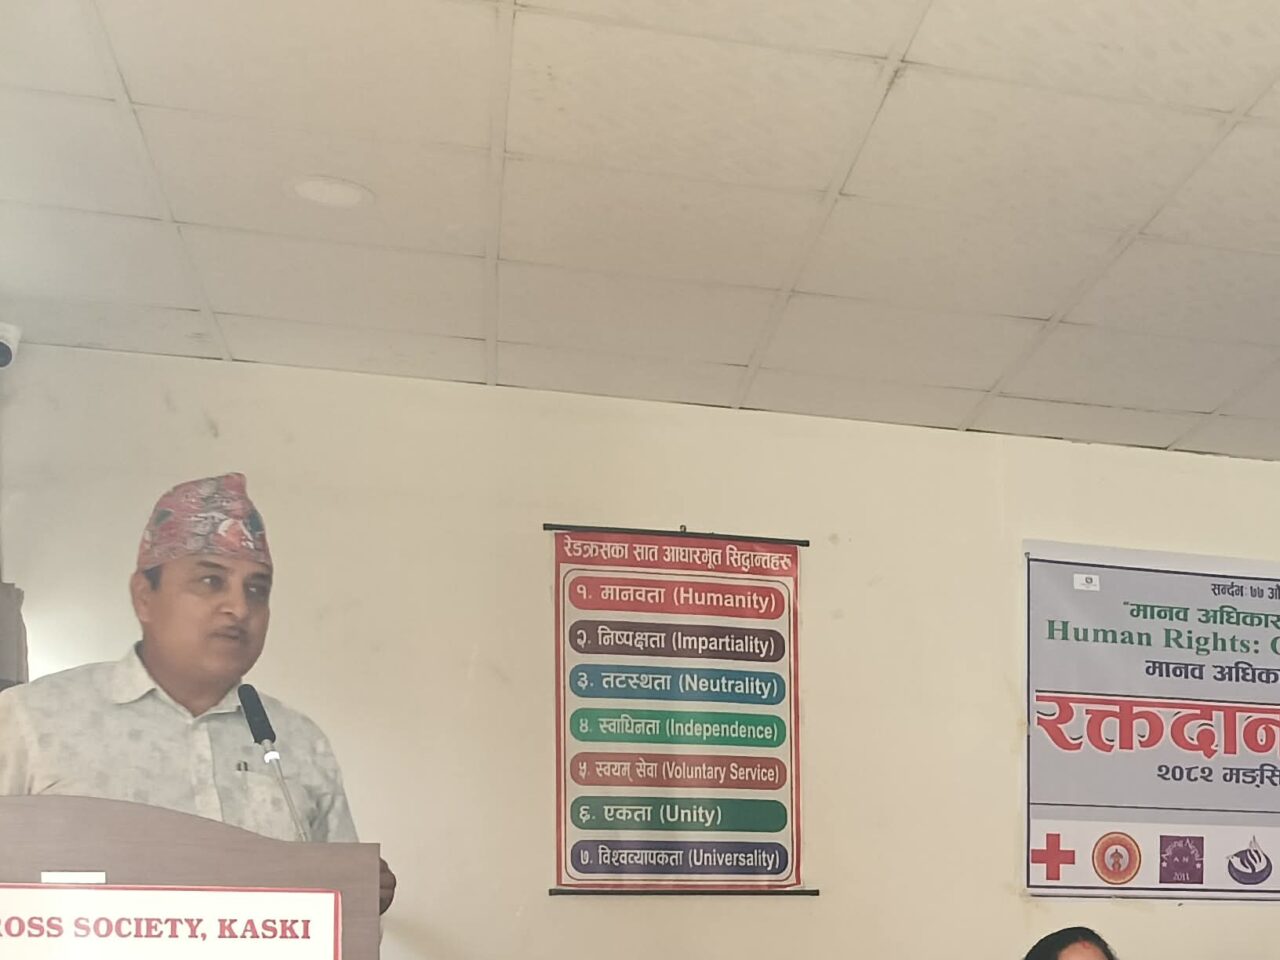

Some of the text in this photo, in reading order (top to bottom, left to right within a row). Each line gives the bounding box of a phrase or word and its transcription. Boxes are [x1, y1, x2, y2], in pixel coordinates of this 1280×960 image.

[632, 542, 658, 562] सात
[599, 585, 666, 606] मानवता
[672, 587, 777, 614] (Humanity)
[597, 625, 666, 650] निष्पक्षता
[671, 630, 775, 657] (Impartiality)
[1046, 619, 1153, 647] Human
[1163, 627, 1260, 656] Rights:
[1145, 659, 1205, 681] मानव
[601, 671, 672, 691] तटस्थता
[678, 673, 778, 698] (Neutrality)
[598, 713, 661, 736] स्वाधिनता
[665, 717, 778, 741] (Independence)
[595, 761, 633, 783] स्वयम्
[636, 757, 658, 779] सेवा
[662, 760, 726, 783] (Voluntary
[729, 761, 780, 783] Service)
[1156, 763, 1214, 783] २०८२
[603, 804, 652, 823] एकता
[659, 804, 722, 827] (Unity)
[688, 846, 781, 870] (Universality)
[0, 916, 311, 941] OSS SOCIETY, KASKI
